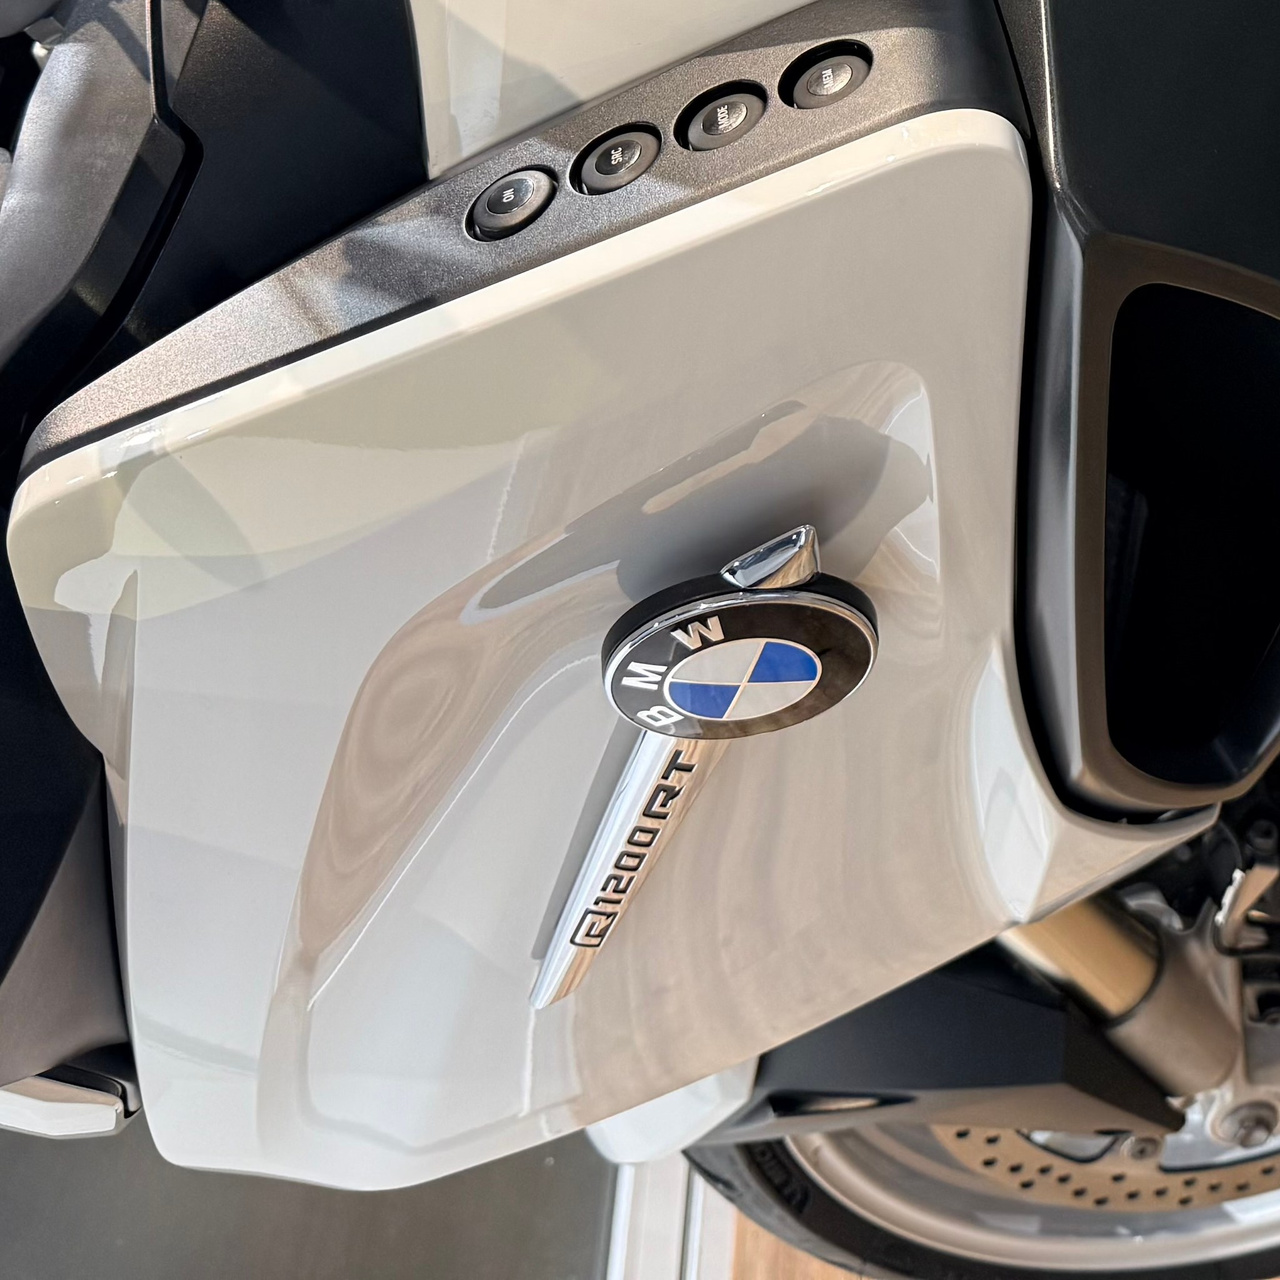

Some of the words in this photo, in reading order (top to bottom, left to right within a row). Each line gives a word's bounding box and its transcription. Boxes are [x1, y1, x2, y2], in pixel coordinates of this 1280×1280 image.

[822, 68, 834, 88] MEM
[717, 104, 730, 130] MODE
[611, 146, 623, 165] SRC
[502, 187, 515, 203] ON
[620, 615, 726, 728] BMW
[569, 748, 698, 948] R1200RT
